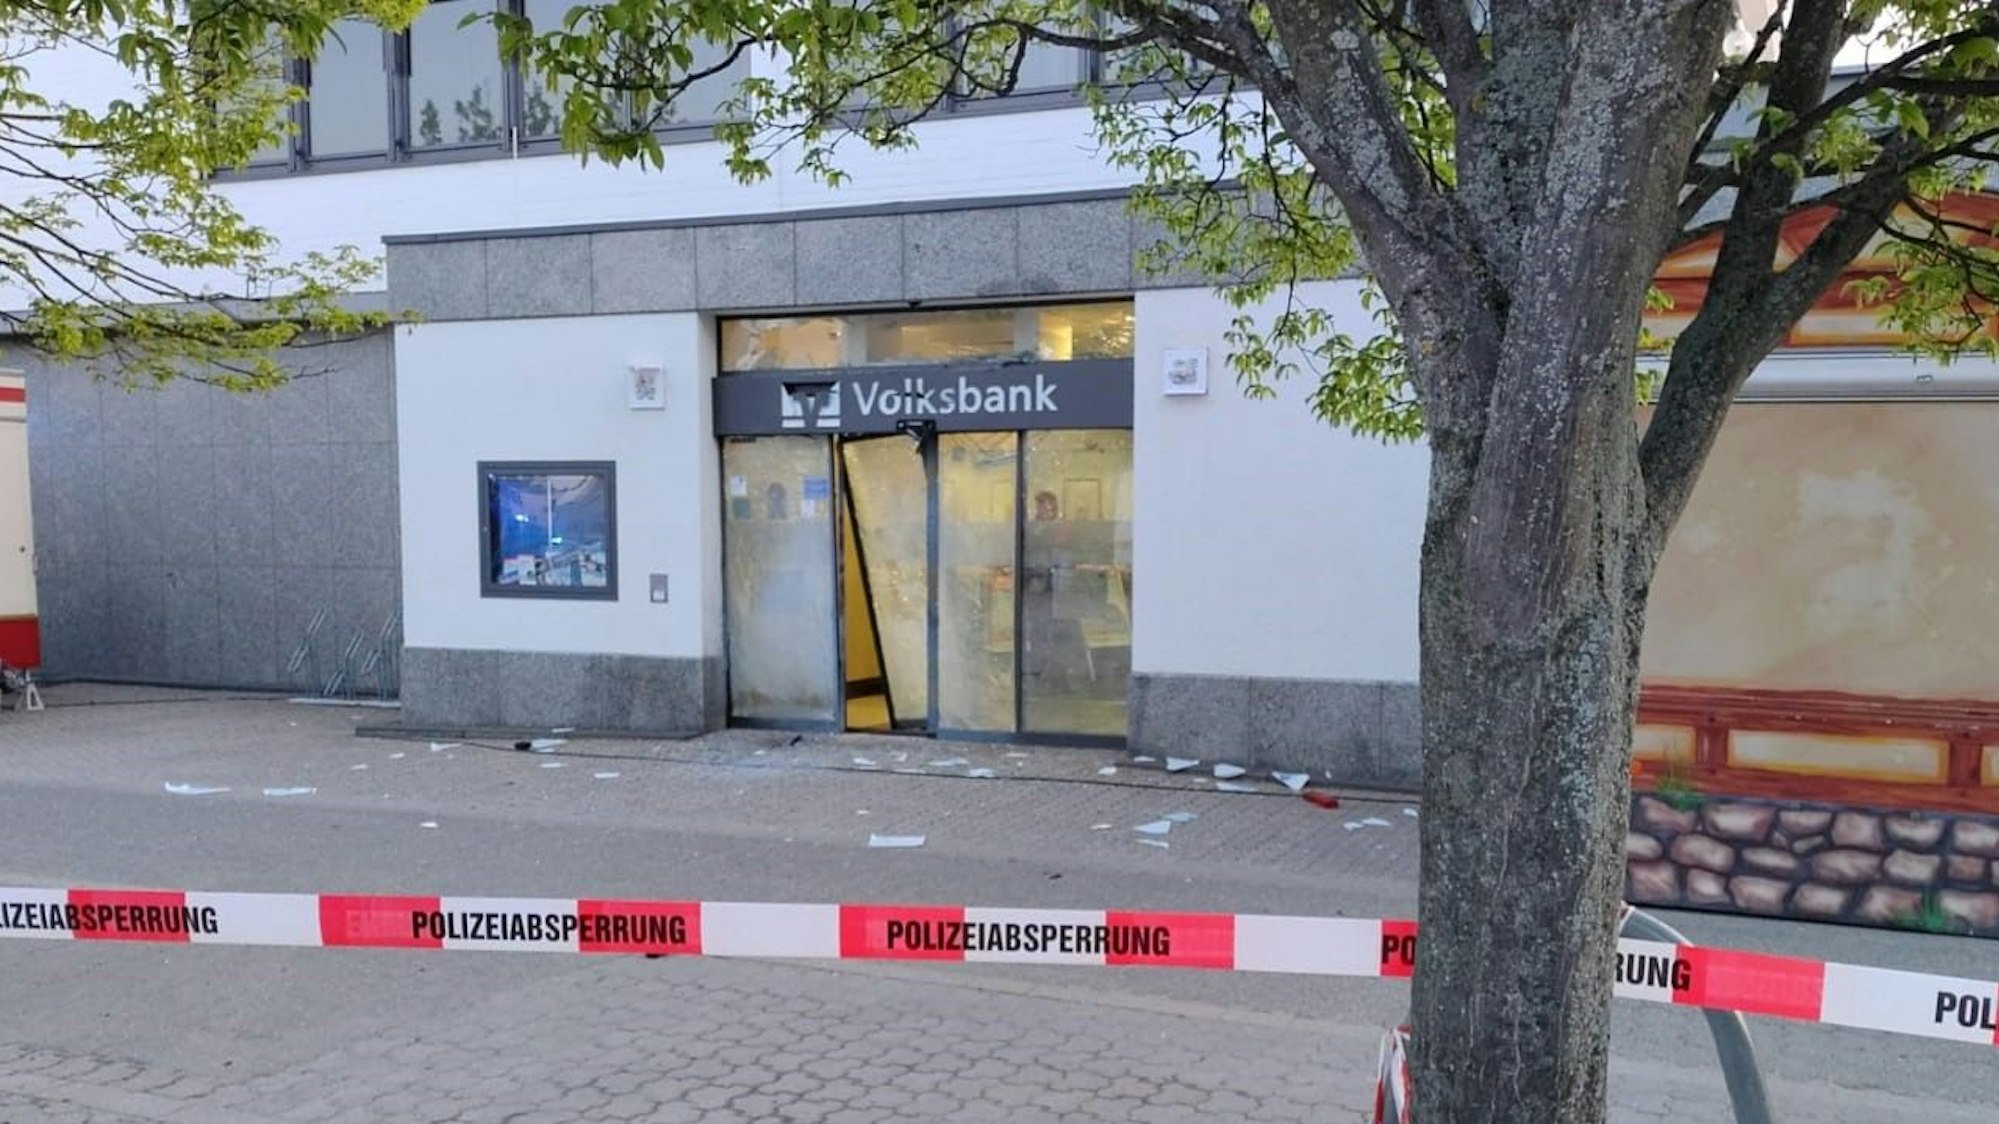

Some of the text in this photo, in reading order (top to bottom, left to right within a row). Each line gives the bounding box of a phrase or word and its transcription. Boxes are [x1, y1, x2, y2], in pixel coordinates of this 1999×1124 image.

[853, 374, 1058, 415] Volksbank
[0, 903, 218, 934] IZEIABSPERRUNG
[412, 911, 686, 944] POLIZEIABSPERRUNG
[887, 920, 1170, 956] POLIZEIABSPERRUNG
[1935, 991, 1999, 1030] POL
